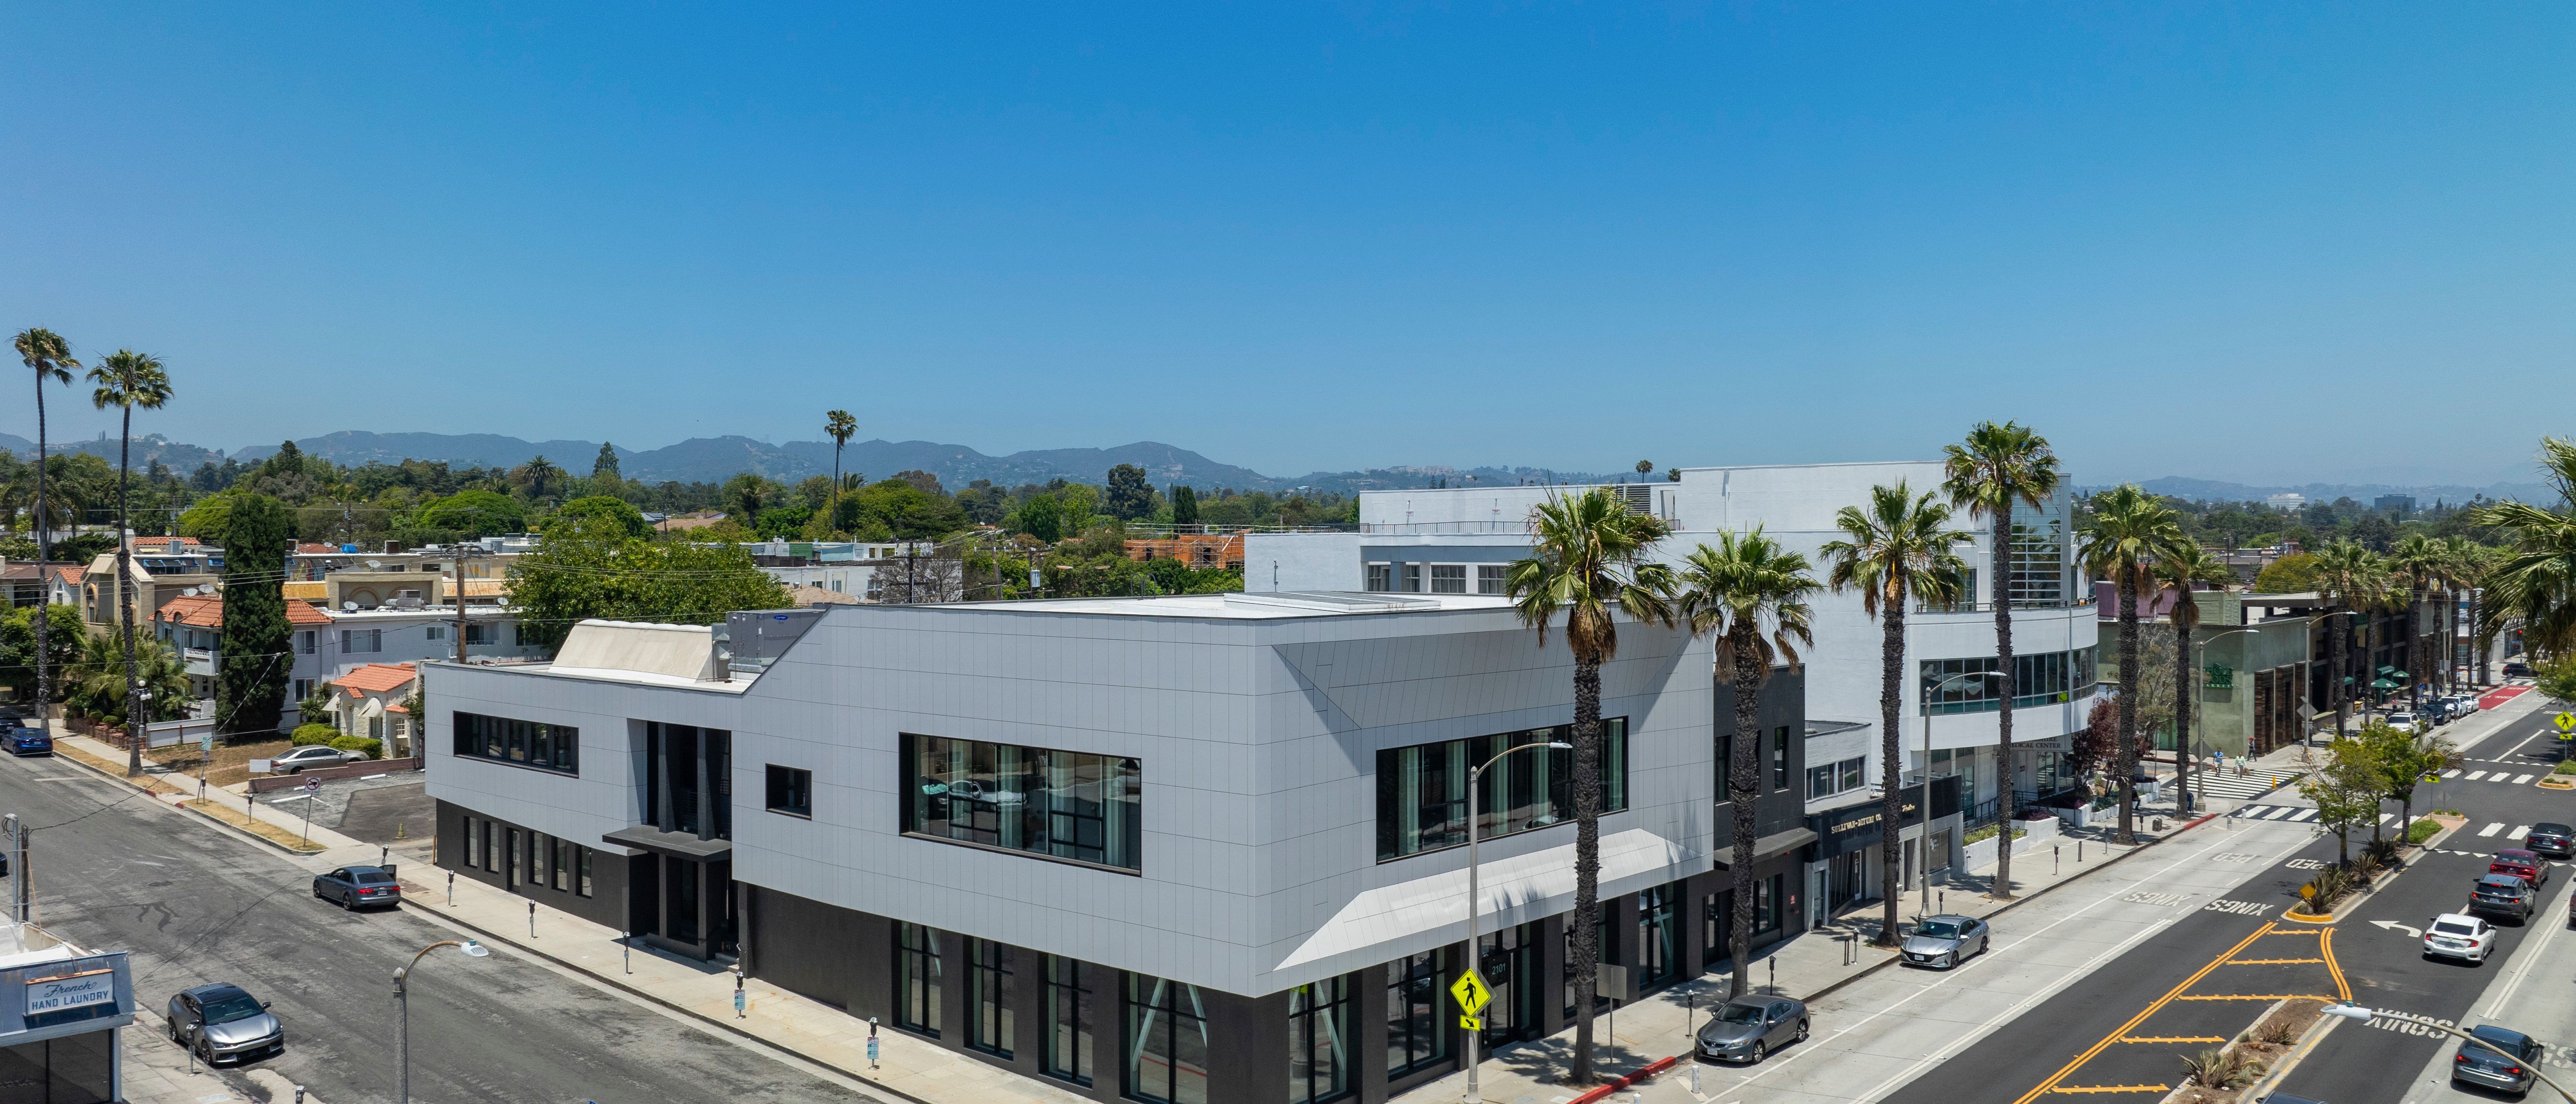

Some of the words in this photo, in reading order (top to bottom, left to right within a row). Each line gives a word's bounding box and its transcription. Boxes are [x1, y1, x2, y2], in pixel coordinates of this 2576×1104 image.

[2212, 852, 2258, 863] PED
[2124, 891, 2192, 907] XINGS
[2204, 899, 2275, 916] XINGS
[1492, 963, 1505, 975] 2101
[44, 980, 97, 997] French
[32, 998, 58, 1010] HAND
[64, 991, 108, 1005] LAUNDRY
[2363, 1008, 2454, 1039] XINGS
